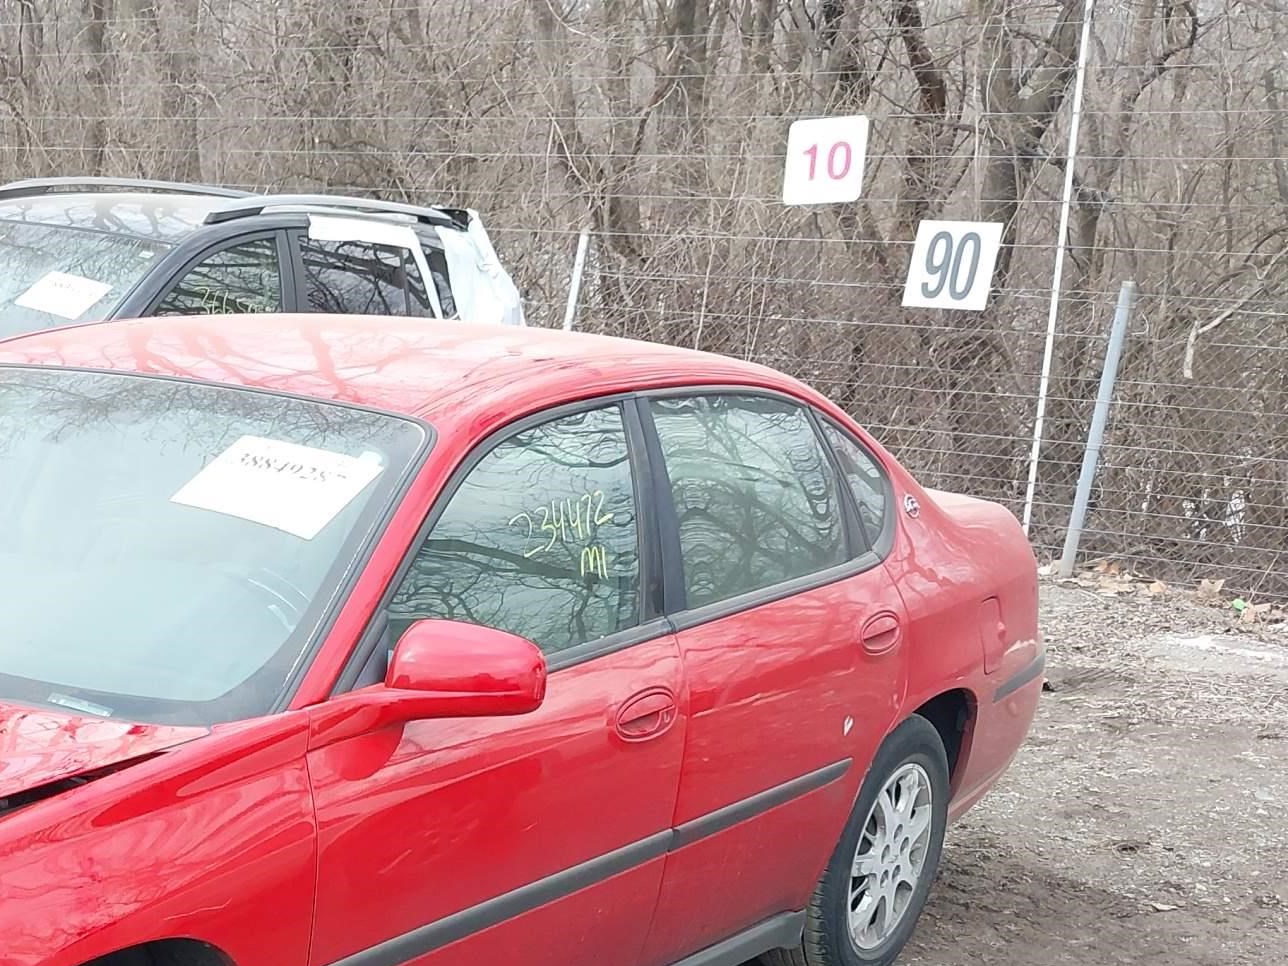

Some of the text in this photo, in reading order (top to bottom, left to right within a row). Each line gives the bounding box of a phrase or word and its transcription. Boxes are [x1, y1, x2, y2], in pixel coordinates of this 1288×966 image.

[802, 141, 852, 181] 10
[920, 231, 982, 301] 90
[508, 489, 614, 558] 234472
